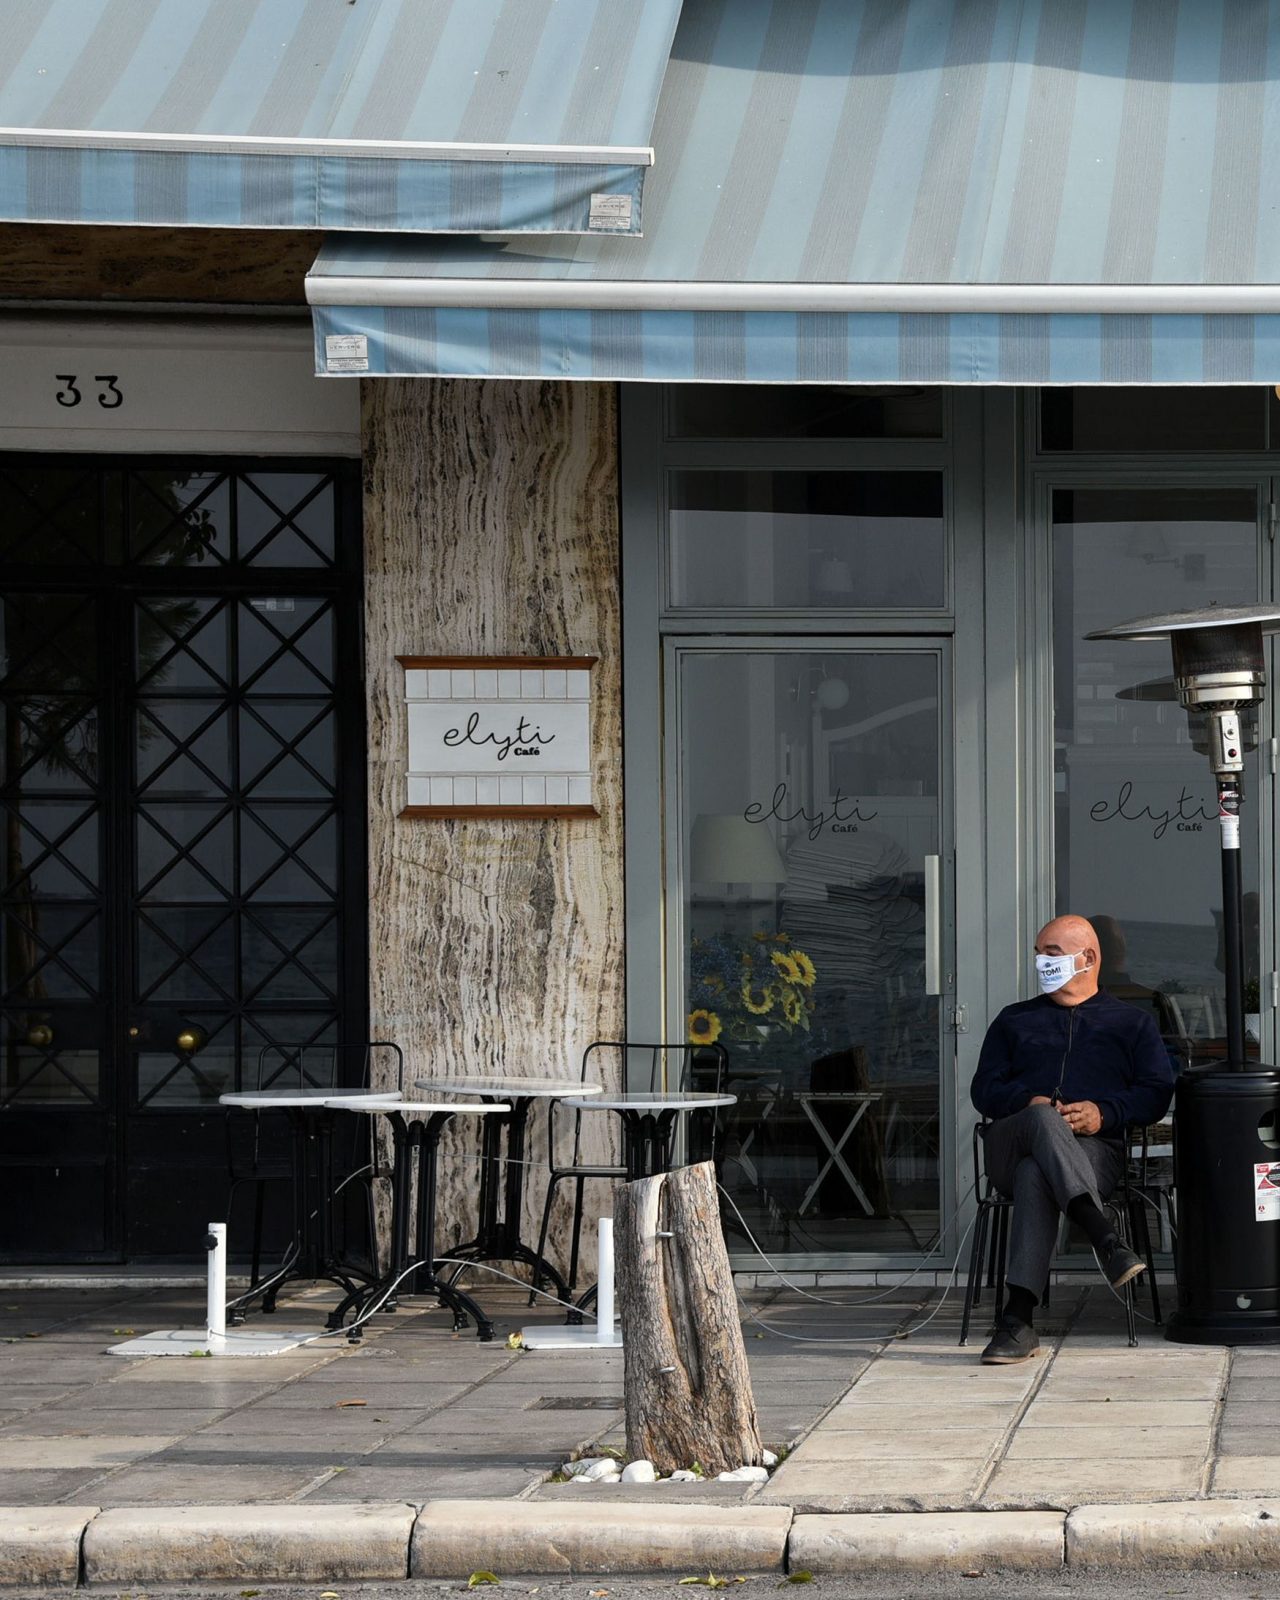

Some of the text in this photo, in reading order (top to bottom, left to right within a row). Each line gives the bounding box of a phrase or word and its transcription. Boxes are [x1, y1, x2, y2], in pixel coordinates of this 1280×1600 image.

[56, 375, 123, 408] 33
[443, 712, 555, 761] elyti
[514, 747, 540, 756] Café
[744, 782, 878, 841] elyti
[1090, 781, 1219, 840] elyti
[831, 824, 858, 833] Café
[1177, 823, 1203, 832] Café
